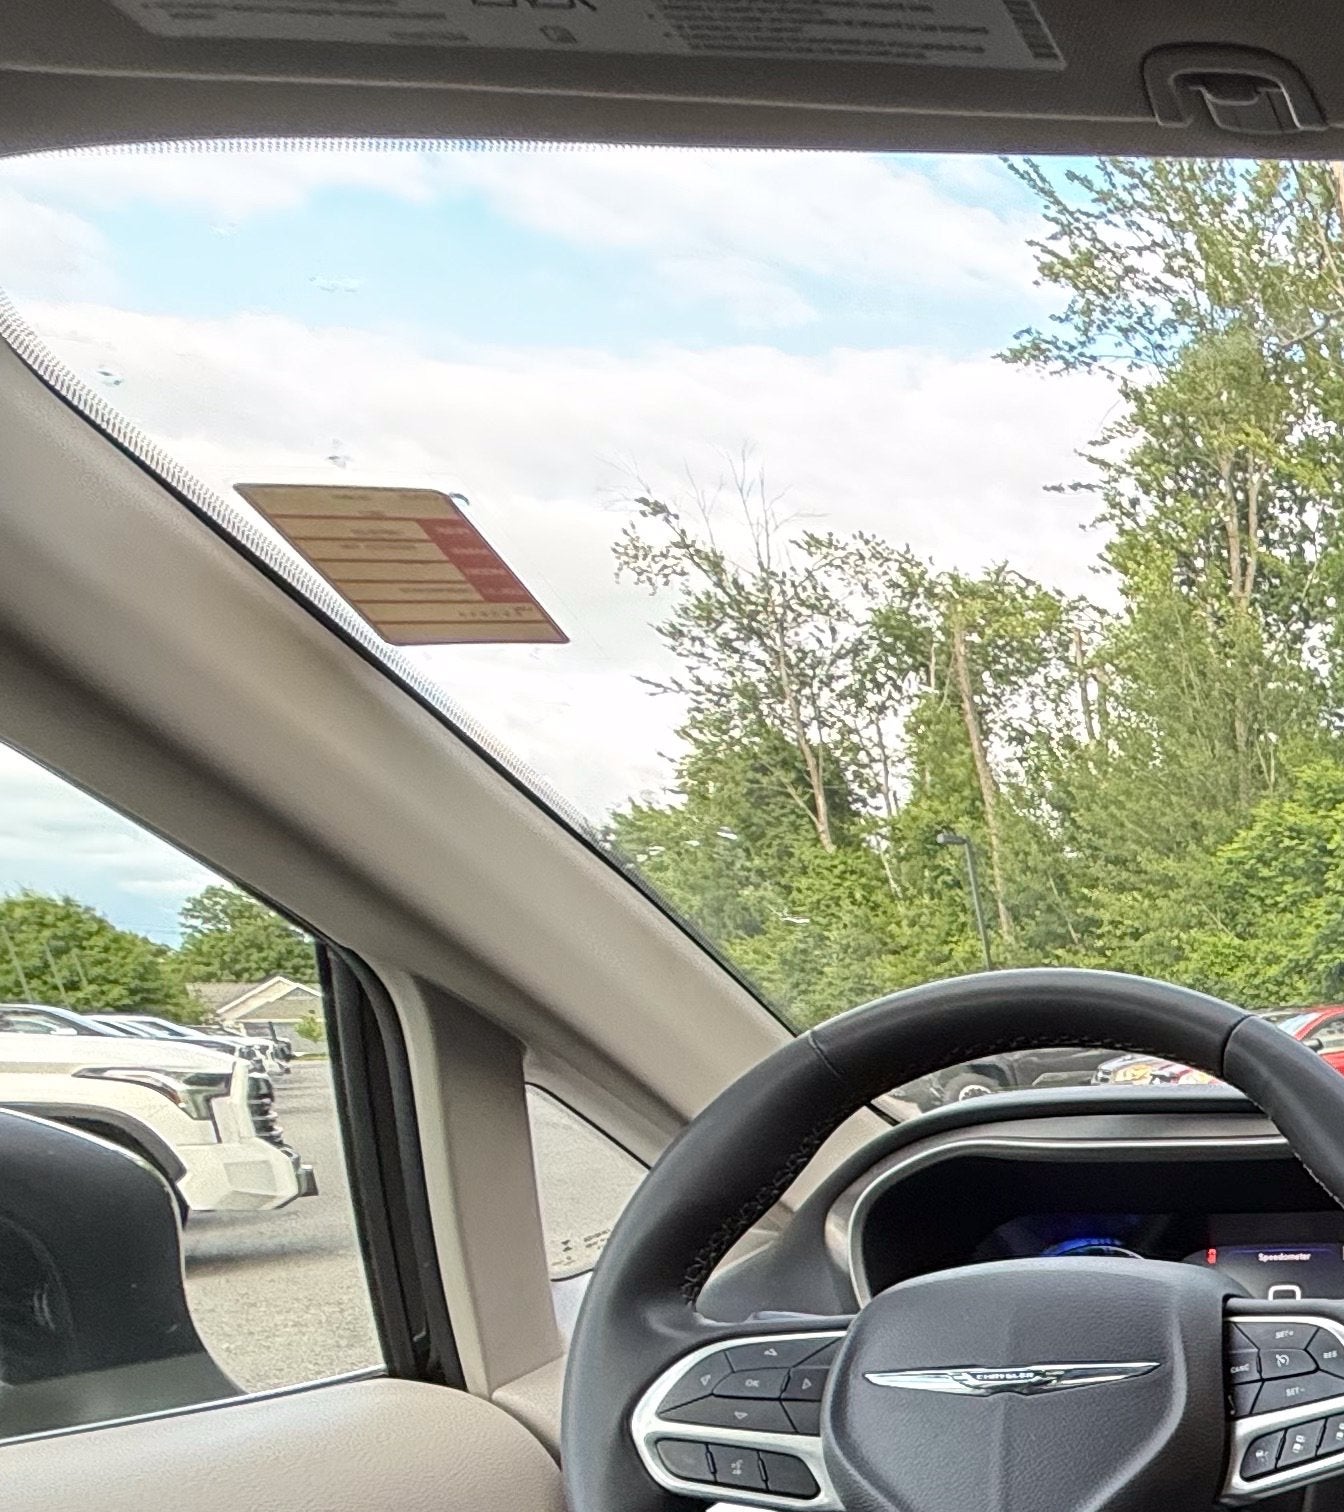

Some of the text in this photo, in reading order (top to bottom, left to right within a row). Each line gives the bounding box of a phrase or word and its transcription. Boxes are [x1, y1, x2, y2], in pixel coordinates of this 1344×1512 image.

[1258, 1252, 1311, 1263] Speedometer
[1323, 1350, 1338, 1359] RES
[975, 1372, 1035, 1380] CHRYSLER
[745, 1379, 760, 1388] OK
